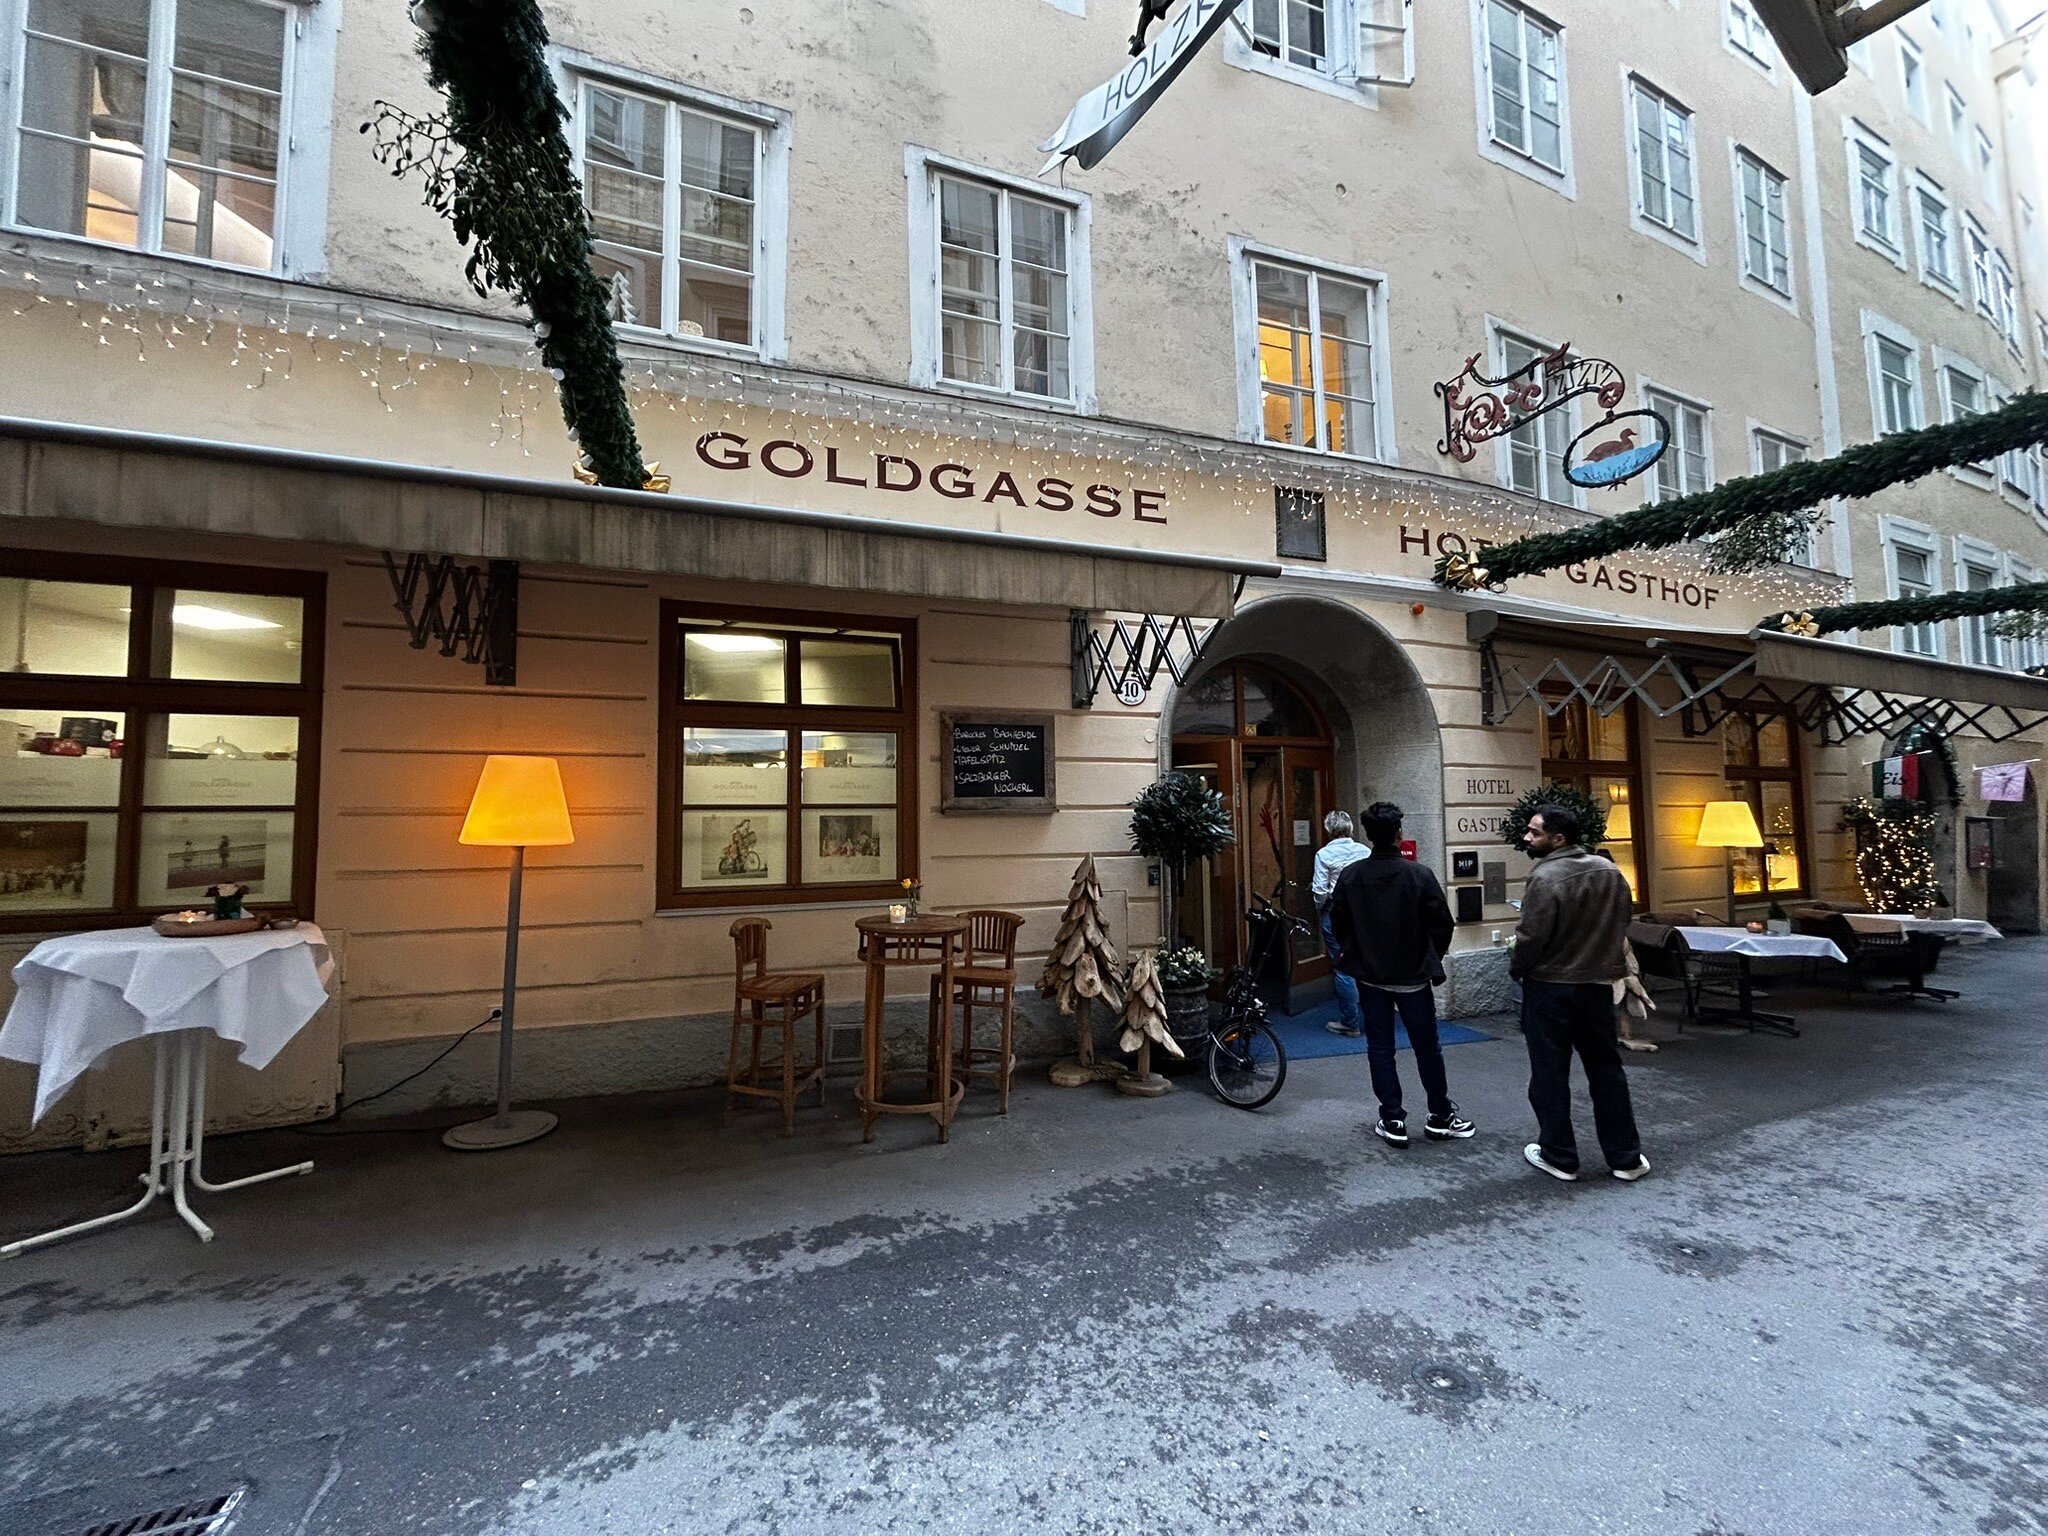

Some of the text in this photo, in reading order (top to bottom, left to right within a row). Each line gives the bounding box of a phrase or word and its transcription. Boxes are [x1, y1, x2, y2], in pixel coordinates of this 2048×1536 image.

[694, 430, 1168, 526] GOLDGASSE
[1564, 562, 1720, 610] GASTHOF
[1124, 682, 1139, 698] 10
[994, 782, 1034, 794] NOCKERL
[1467, 779, 1515, 795] HOTEL
